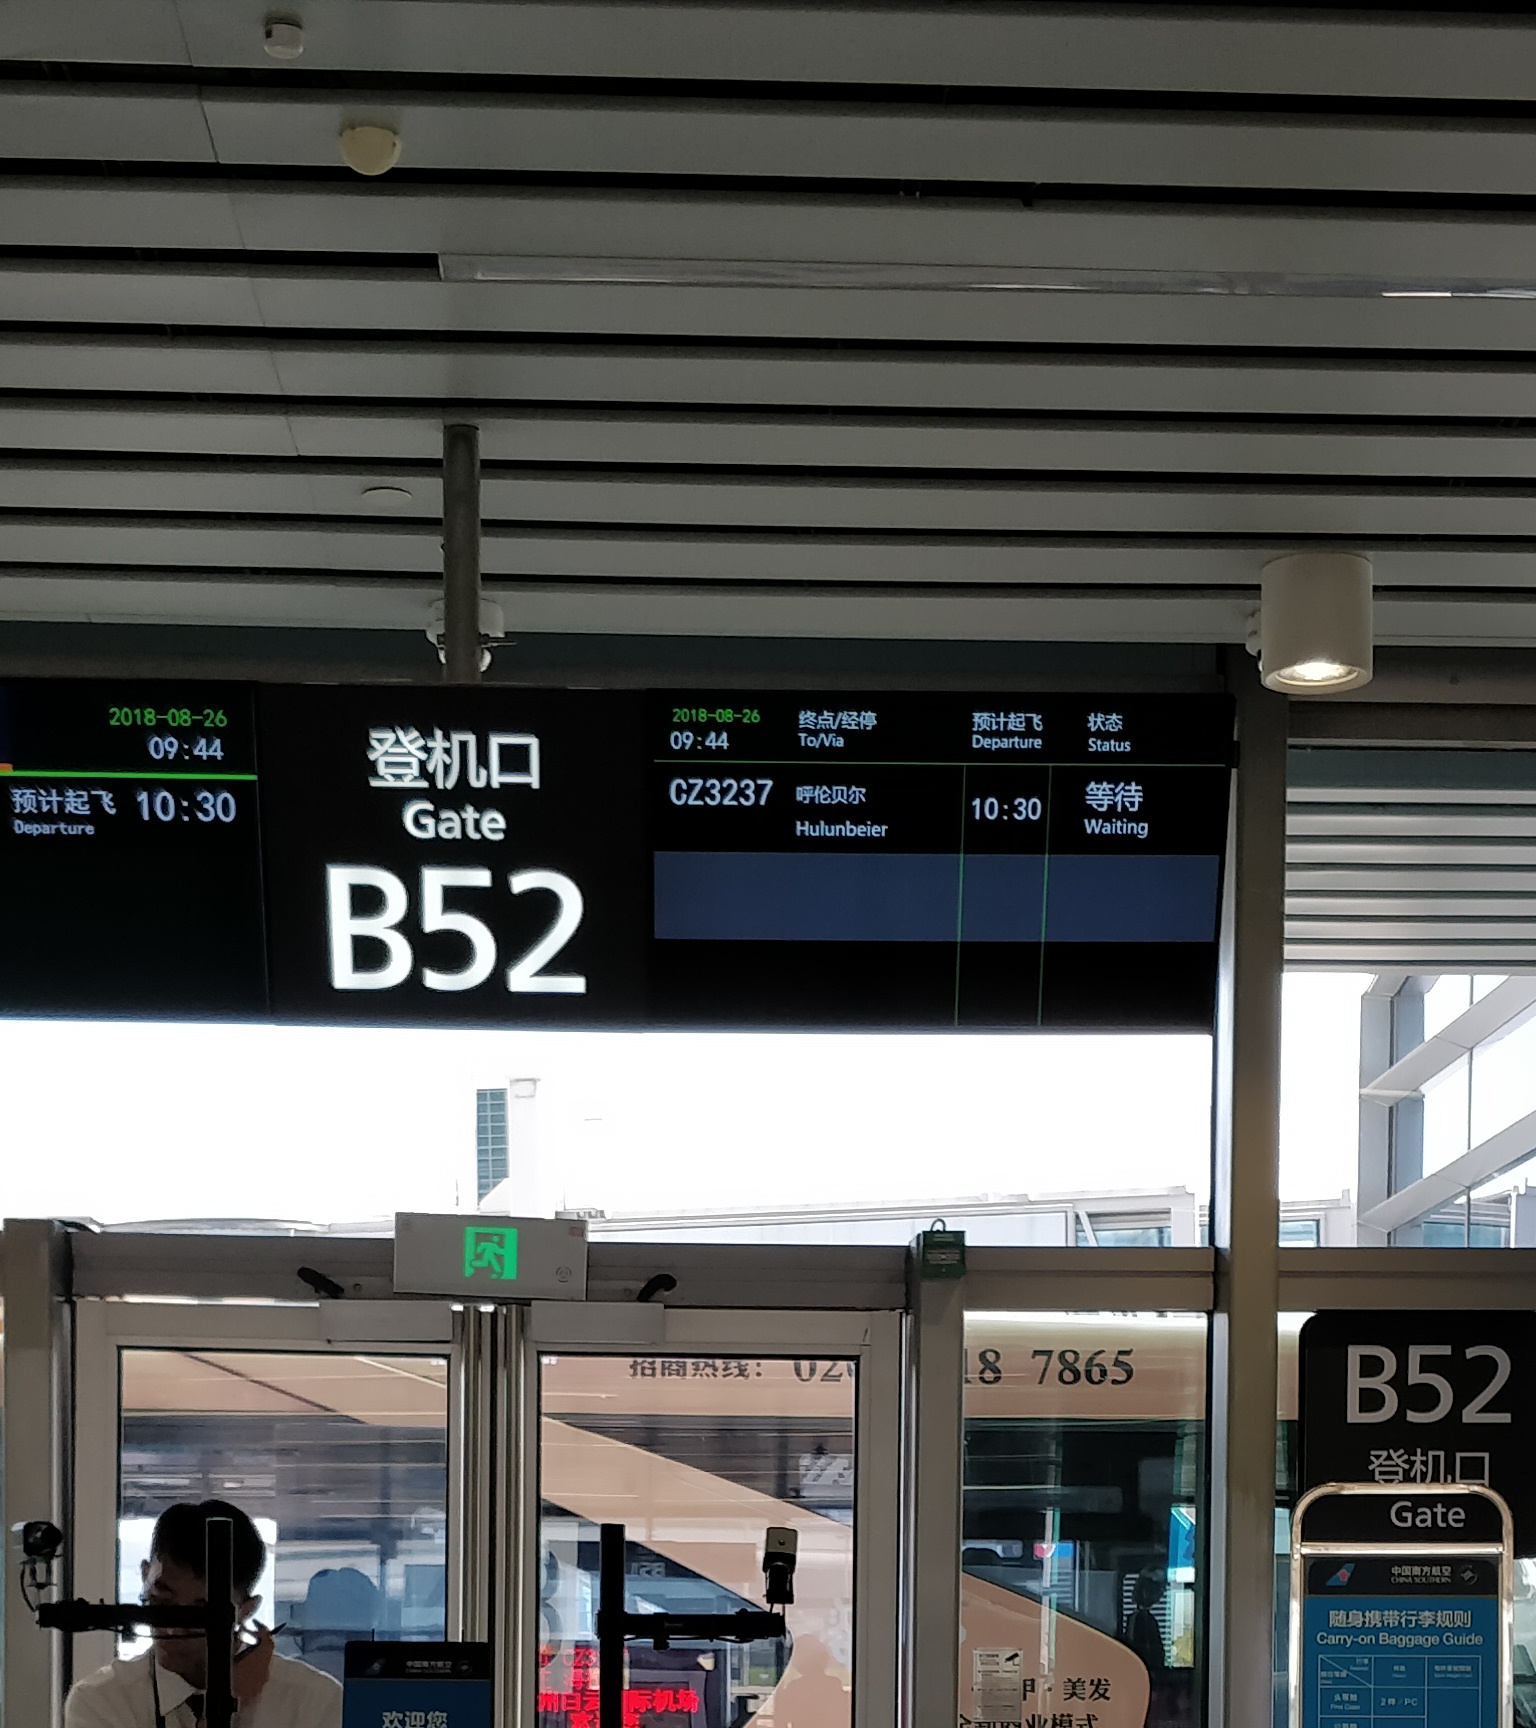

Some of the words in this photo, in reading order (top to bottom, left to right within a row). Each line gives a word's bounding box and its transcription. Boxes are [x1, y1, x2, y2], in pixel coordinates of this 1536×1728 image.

[109, 707, 228, 728] 2018-08-26
[672, 709, 761, 723] 2018-08-26
[798, 711, 877, 731] 终点/经停
[971, 712, 1043, 733] 预计起飞
[1087, 713, 1123, 732] 状态
[148, 737, 224, 761] 09:44
[670, 731, 730, 750] 09:44
[799, 734, 845, 749] To/Via
[971, 735, 1043, 751] Departure
[1088, 738, 1132, 753] Status
[367, 725, 540, 789] 登机口
[669, 778, 774, 806] CZ3237
[795, 786, 867, 805] 呼伦贝尔
[1084, 781, 1144, 813] 等待
[11, 788, 117, 815] 预计起飞
[135, 791, 237, 823] 10:30
[971, 798, 1042, 820] 10:30
[14, 820, 96, 836] Departure
[402, 798, 507, 841] Gate
[796, 821, 888, 838] Hulunbeier
[1084, 818, 1149, 839] Waiting
[326, 864, 587, 994] B52
[793, 1360, 855, 1383] 02
[1031, 1348, 1134, 1386] 7865
[1346, 1344, 1512, 1423] B52
[1368, 1448, 1490, 1485] 登机口
[1390, 1501, 1465, 1528] Gate
[1391, 1566, 1451, 1576] 中国南方航空
[1329, 1610, 1472, 1629] 随身携带行李规则
[1316, 1633, 1376, 1647] Carry-on
[1379, 1633, 1440, 1648] Baggage
[1443, 1633, 1483, 1645] Guide
[538, 1689, 699, 1712] 州白云际机场
